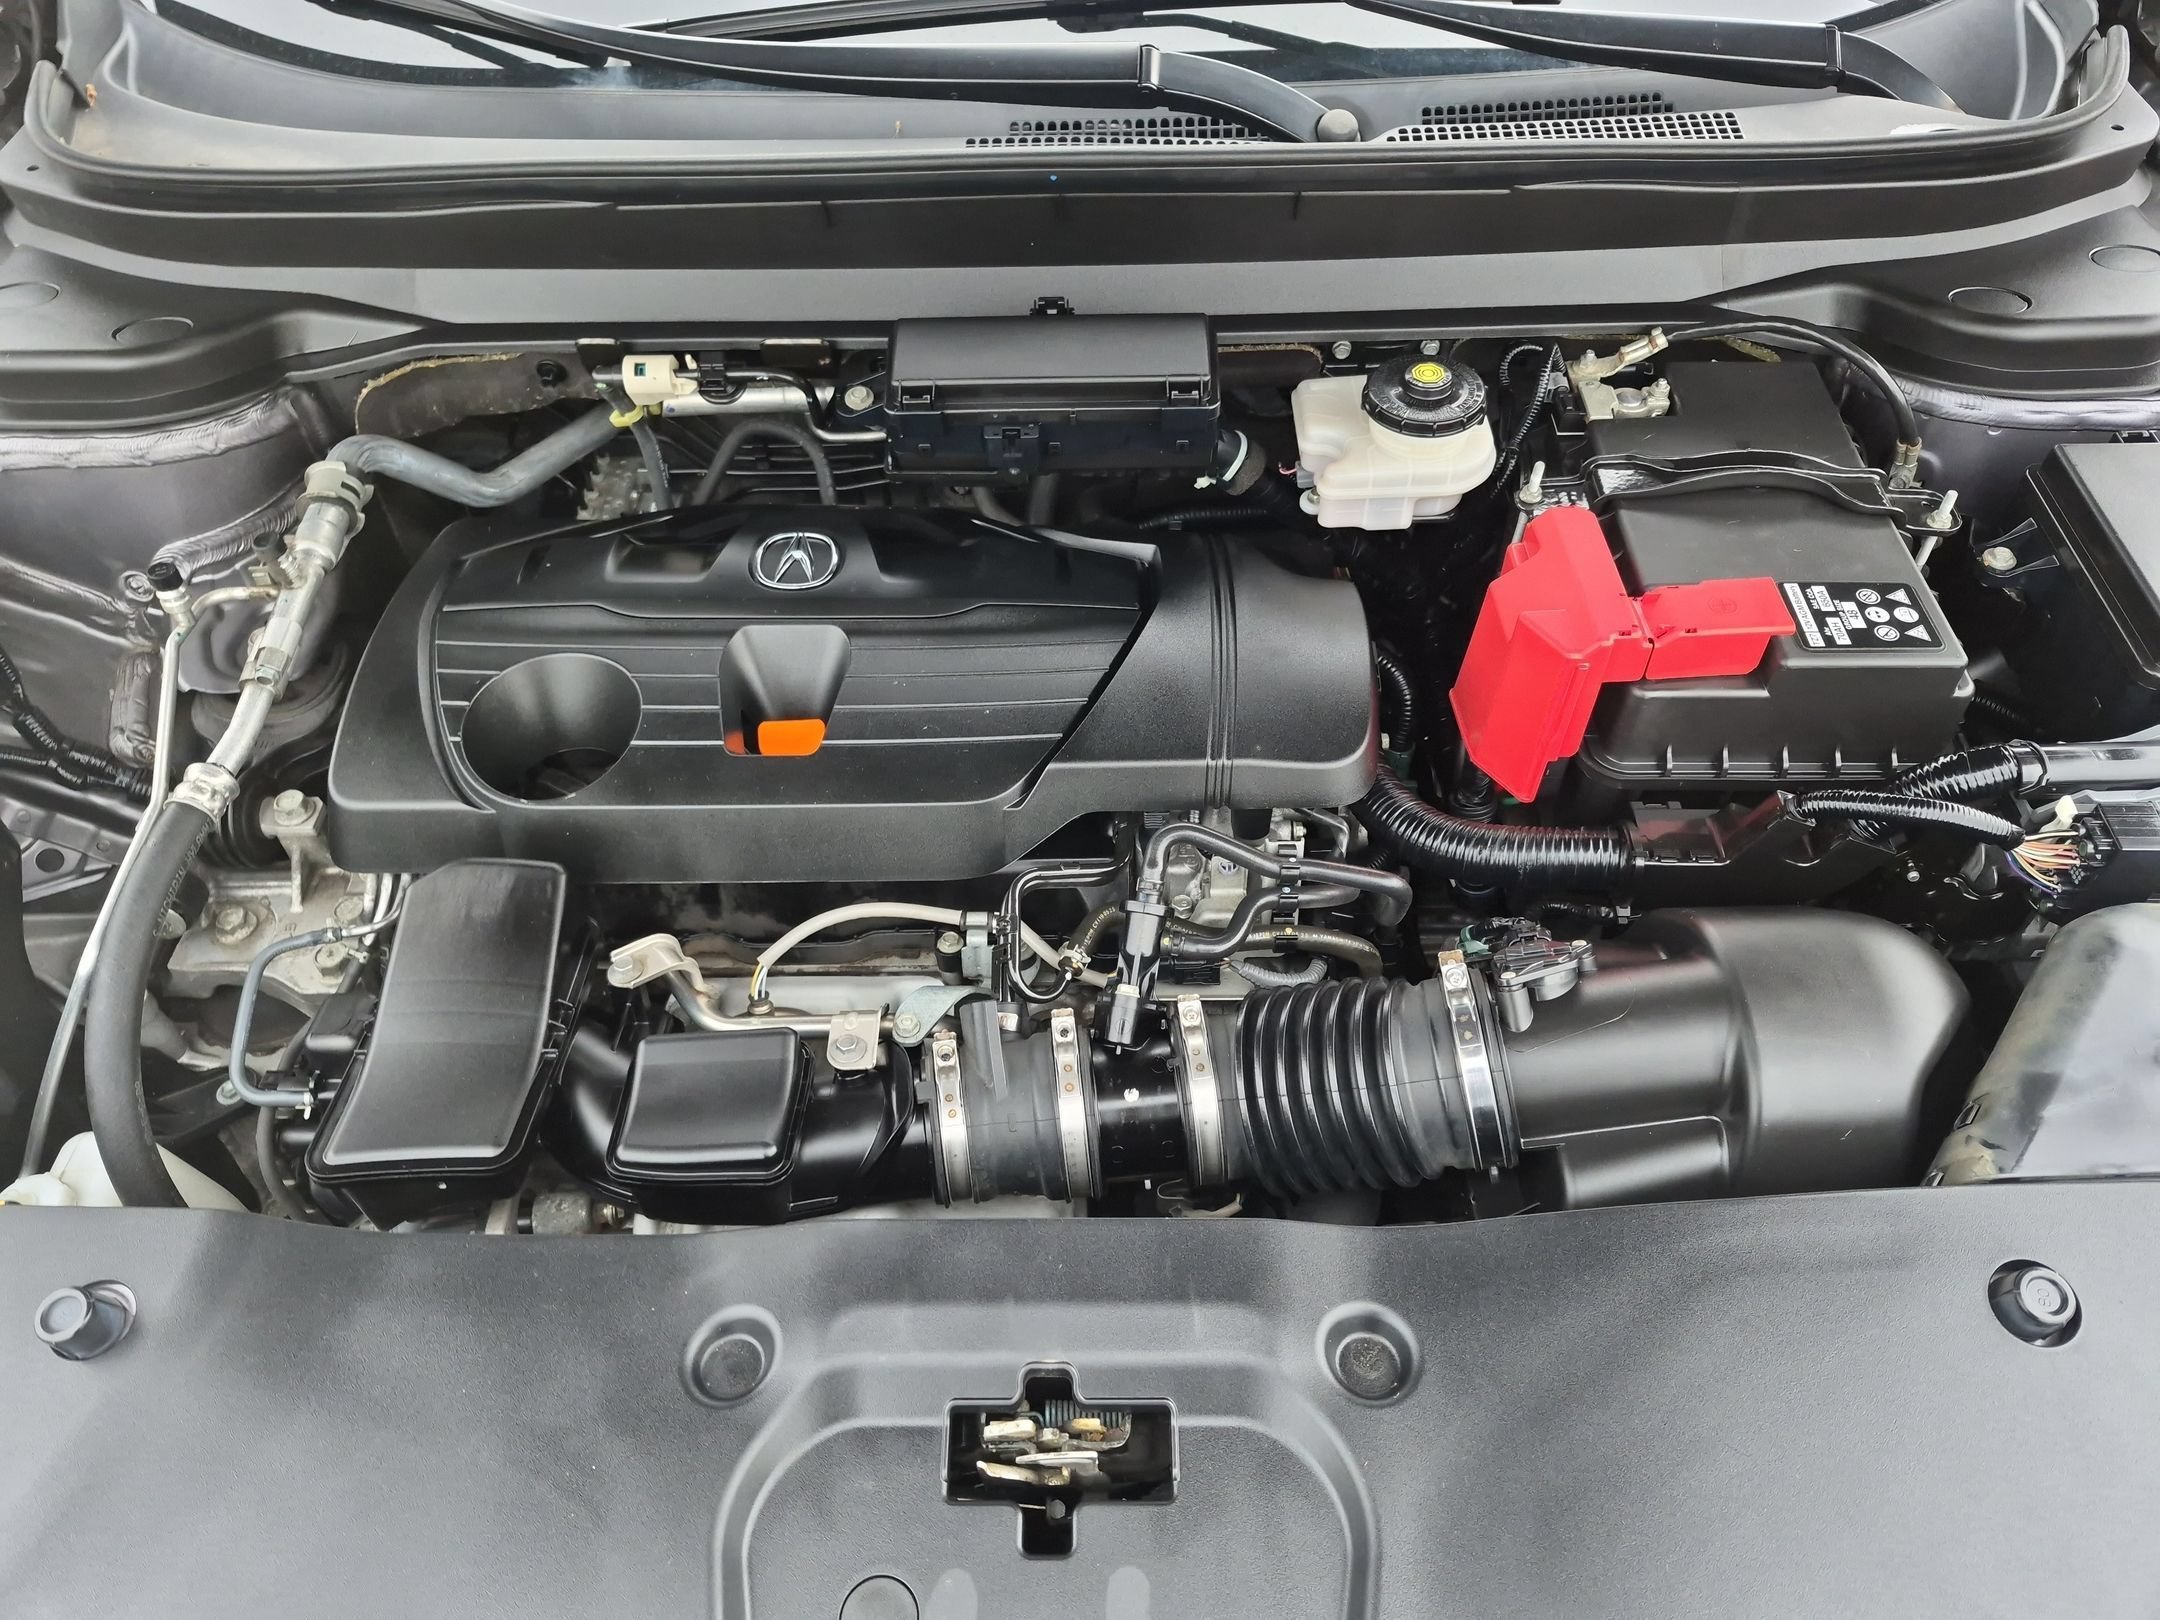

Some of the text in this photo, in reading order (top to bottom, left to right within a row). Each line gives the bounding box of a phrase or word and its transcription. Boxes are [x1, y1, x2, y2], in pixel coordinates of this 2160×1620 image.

[1790, 585, 1803, 605] Battery
[1805, 588, 1820, 610] SAE CCA
[1796, 604, 1808, 619] AGM
[1832, 599, 1853, 630] GROUP SIZE
[1830, 622, 1848, 640] 70AH
